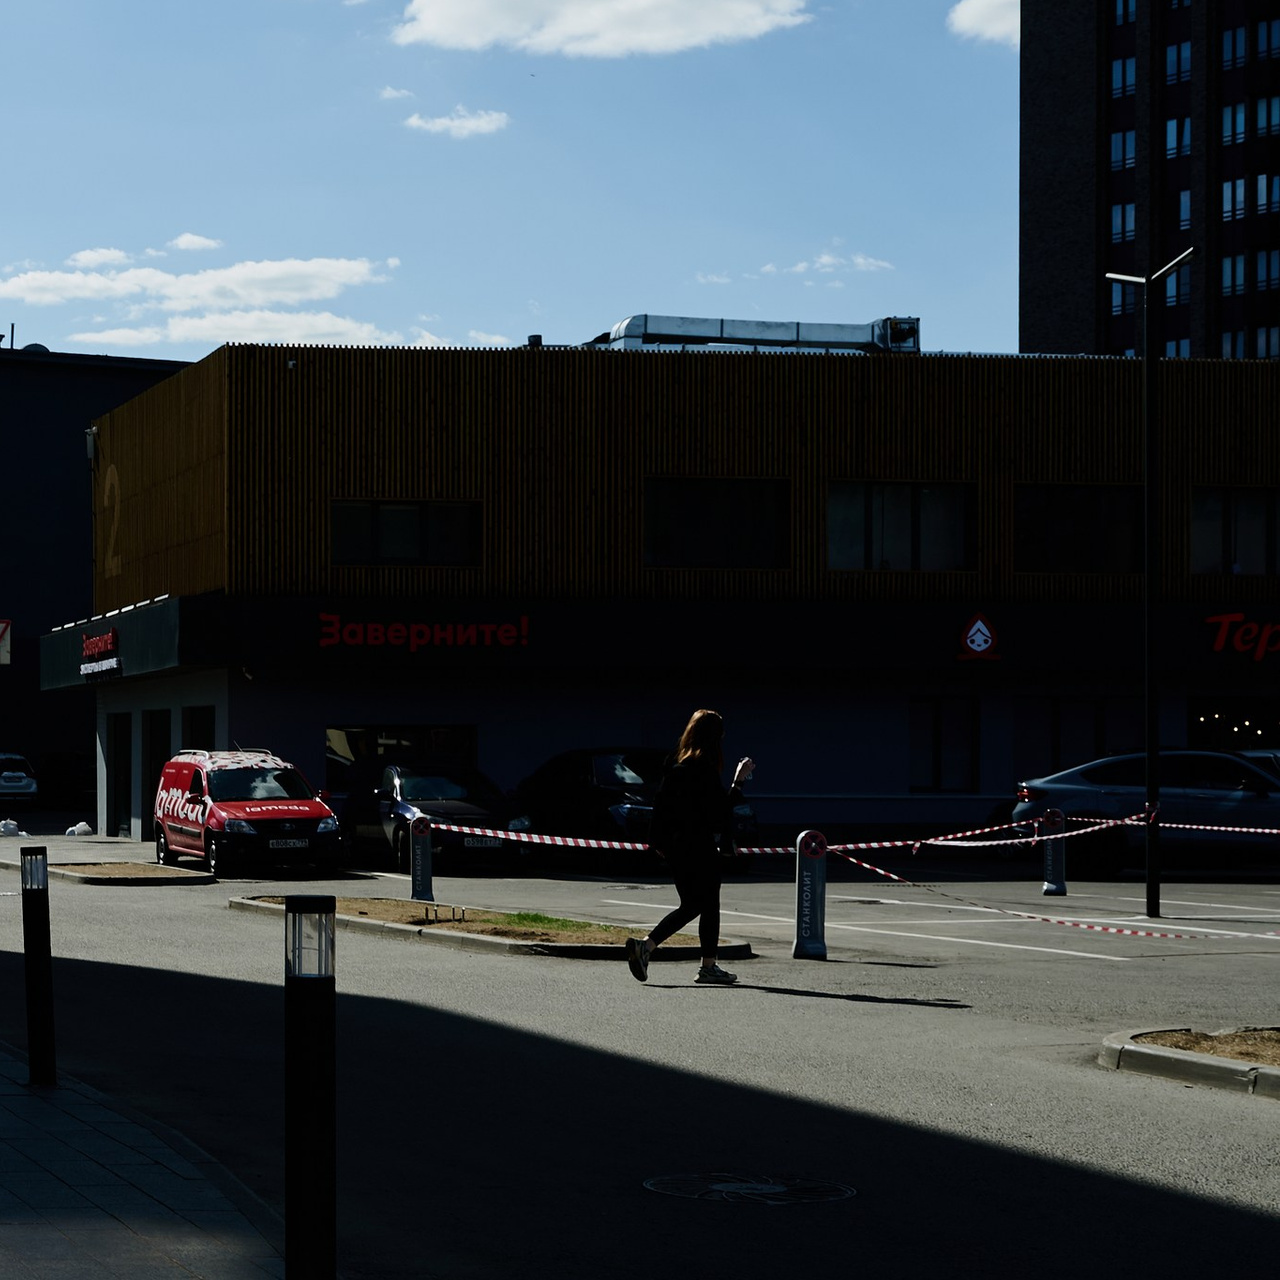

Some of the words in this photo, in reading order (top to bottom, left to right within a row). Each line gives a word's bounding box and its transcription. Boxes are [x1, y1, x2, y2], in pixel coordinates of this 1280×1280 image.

[104, 464, 121, 579] 2
[317, 612, 530, 654] Заверните!
[245, 805, 310, 813] lamoda
[802, 871, 812, 937] СТАНКОЛИТ
